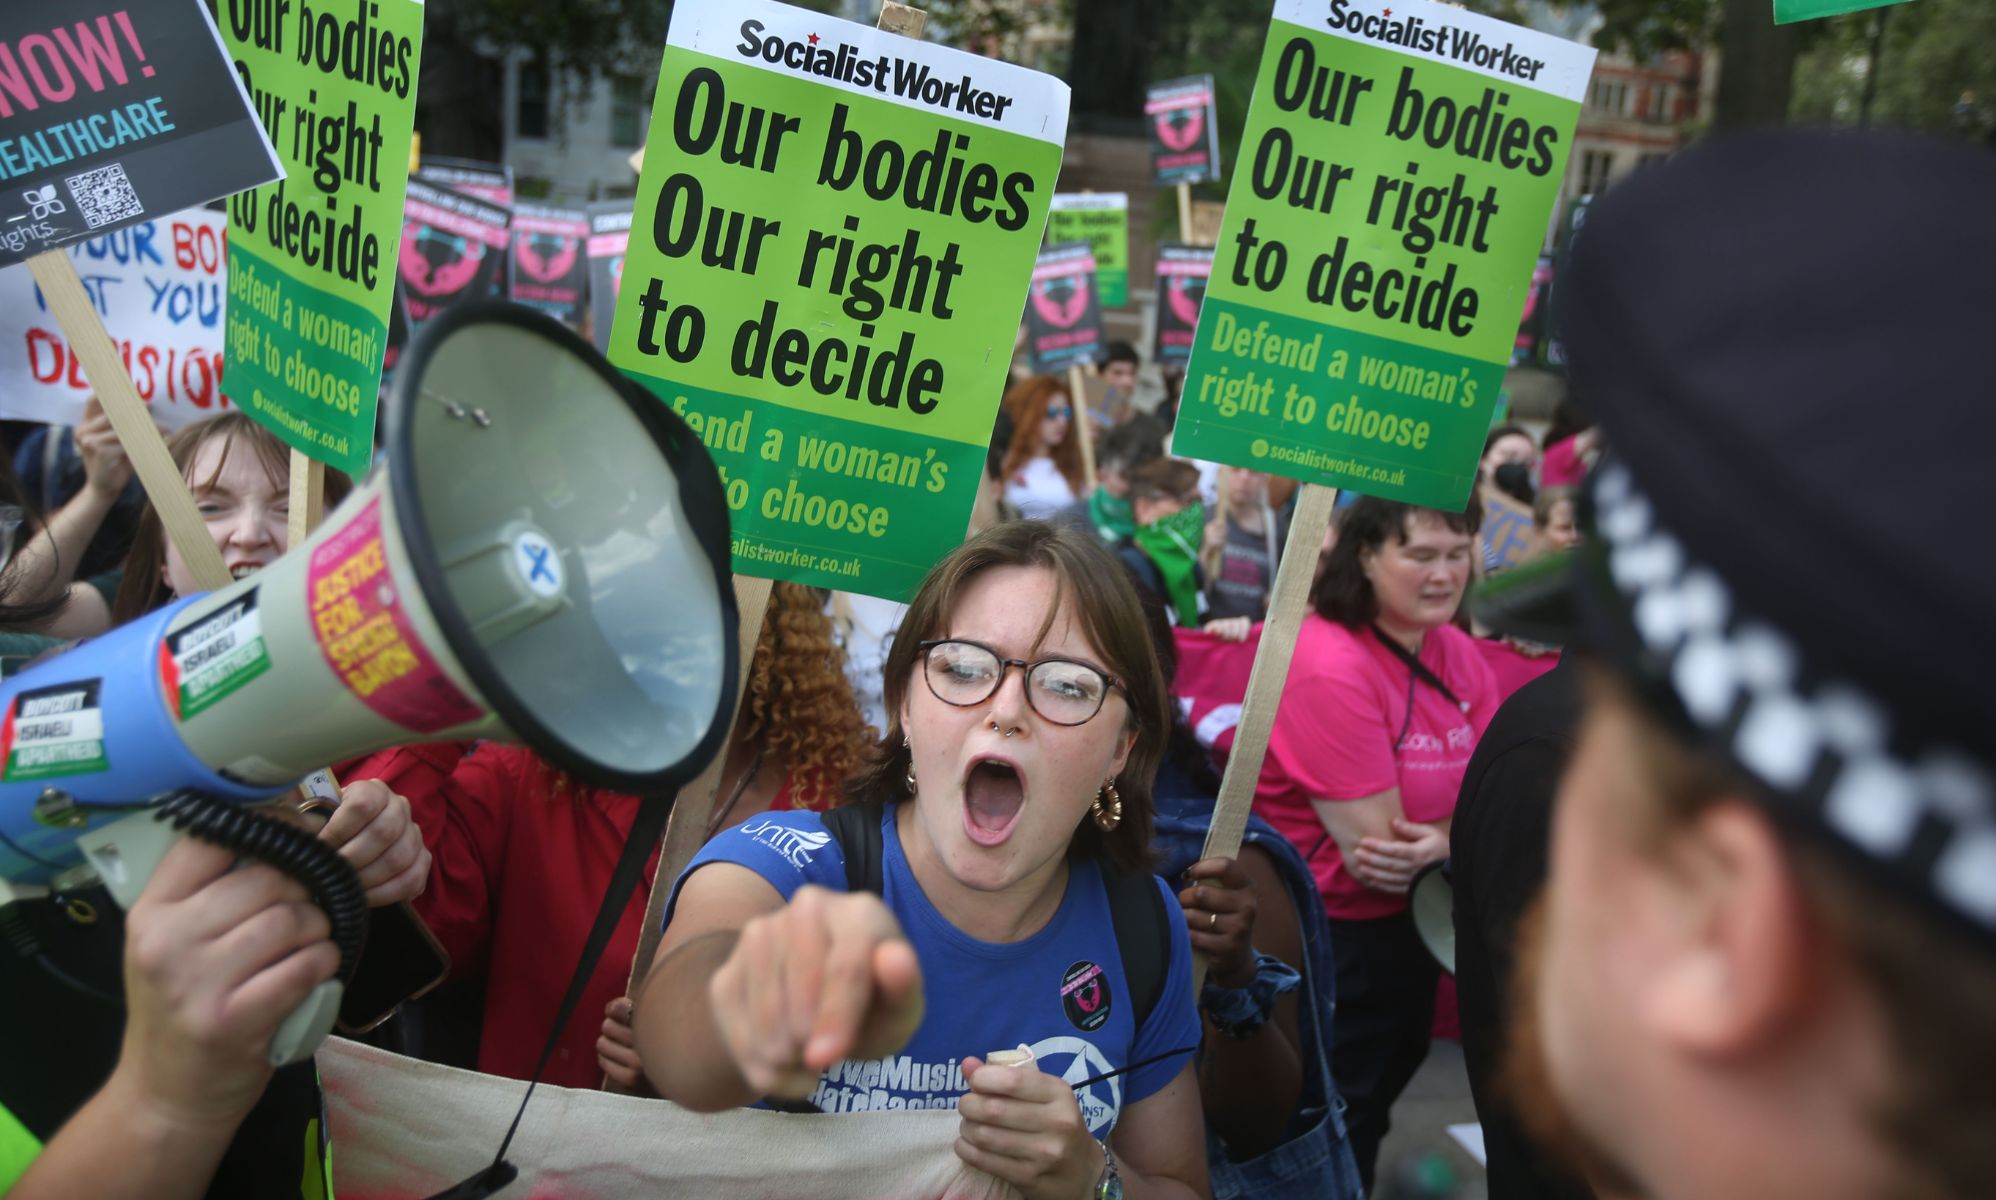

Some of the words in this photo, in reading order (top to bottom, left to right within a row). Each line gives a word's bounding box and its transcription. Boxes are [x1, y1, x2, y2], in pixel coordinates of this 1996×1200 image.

[0, 10, 156, 118] NOW!
[297, 0, 412, 99] bodies
[293, 89, 383, 193] right
[673, 66, 801, 174] Our
[817, 102, 1035, 231] bodies
[1273, 37, 1374, 126] Our
[1385, 66, 1558, 176] bodies
[0, 221, 55, 252] ights
[268, 179, 379, 291] decide
[1252, 127, 1354, 214] Our
[1366, 162, 1499, 253] right
[230, 253, 281, 323] Defend
[283, 297, 292, 331] a
[653, 172, 781, 275] Our
[798, 215, 963, 321] right
[1232, 218, 1288, 292] to
[1306, 236, 1479, 337] decide
[229, 310, 260, 365] right
[264, 333, 280, 378] to
[285, 350, 360, 417] choose
[637, 277, 705, 363] to
[731, 299, 943, 415] decide
[1211, 311, 1323, 373] Defend
[1327, 349, 1349, 380] a
[1358, 356, 1478, 408] woman's
[760, 428, 784, 462] a
[798, 435, 948, 493] woman's
[1199, 366, 1274, 417] right
[1283, 384, 1317, 424] to
[1327, 396, 1430, 450] choose
[761, 480, 889, 537] choose
[1270, 445, 1406, 486] socialistworker.co.uk
